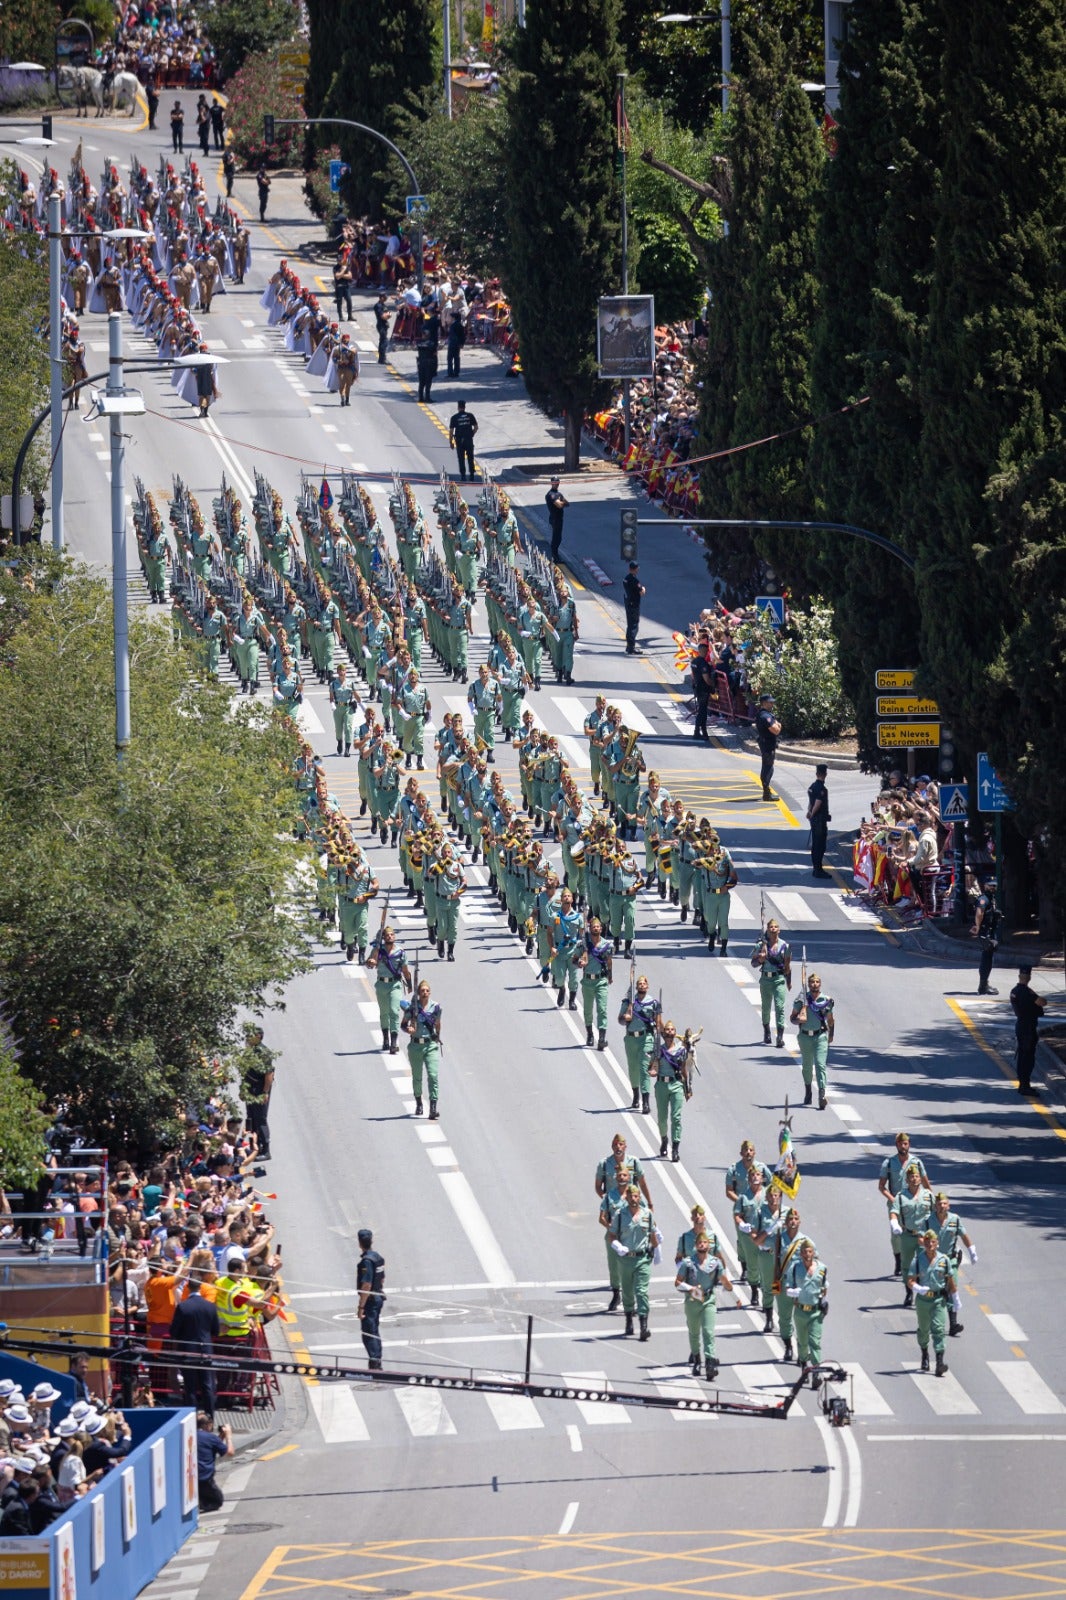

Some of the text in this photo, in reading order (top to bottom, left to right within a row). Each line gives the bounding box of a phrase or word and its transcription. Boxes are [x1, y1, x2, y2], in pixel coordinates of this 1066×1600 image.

[900, 730, 930, 738] Nieves
[881, 738, 935, 746] Sacromonte
[0, 1560, 37, 1569] RIBUNA
